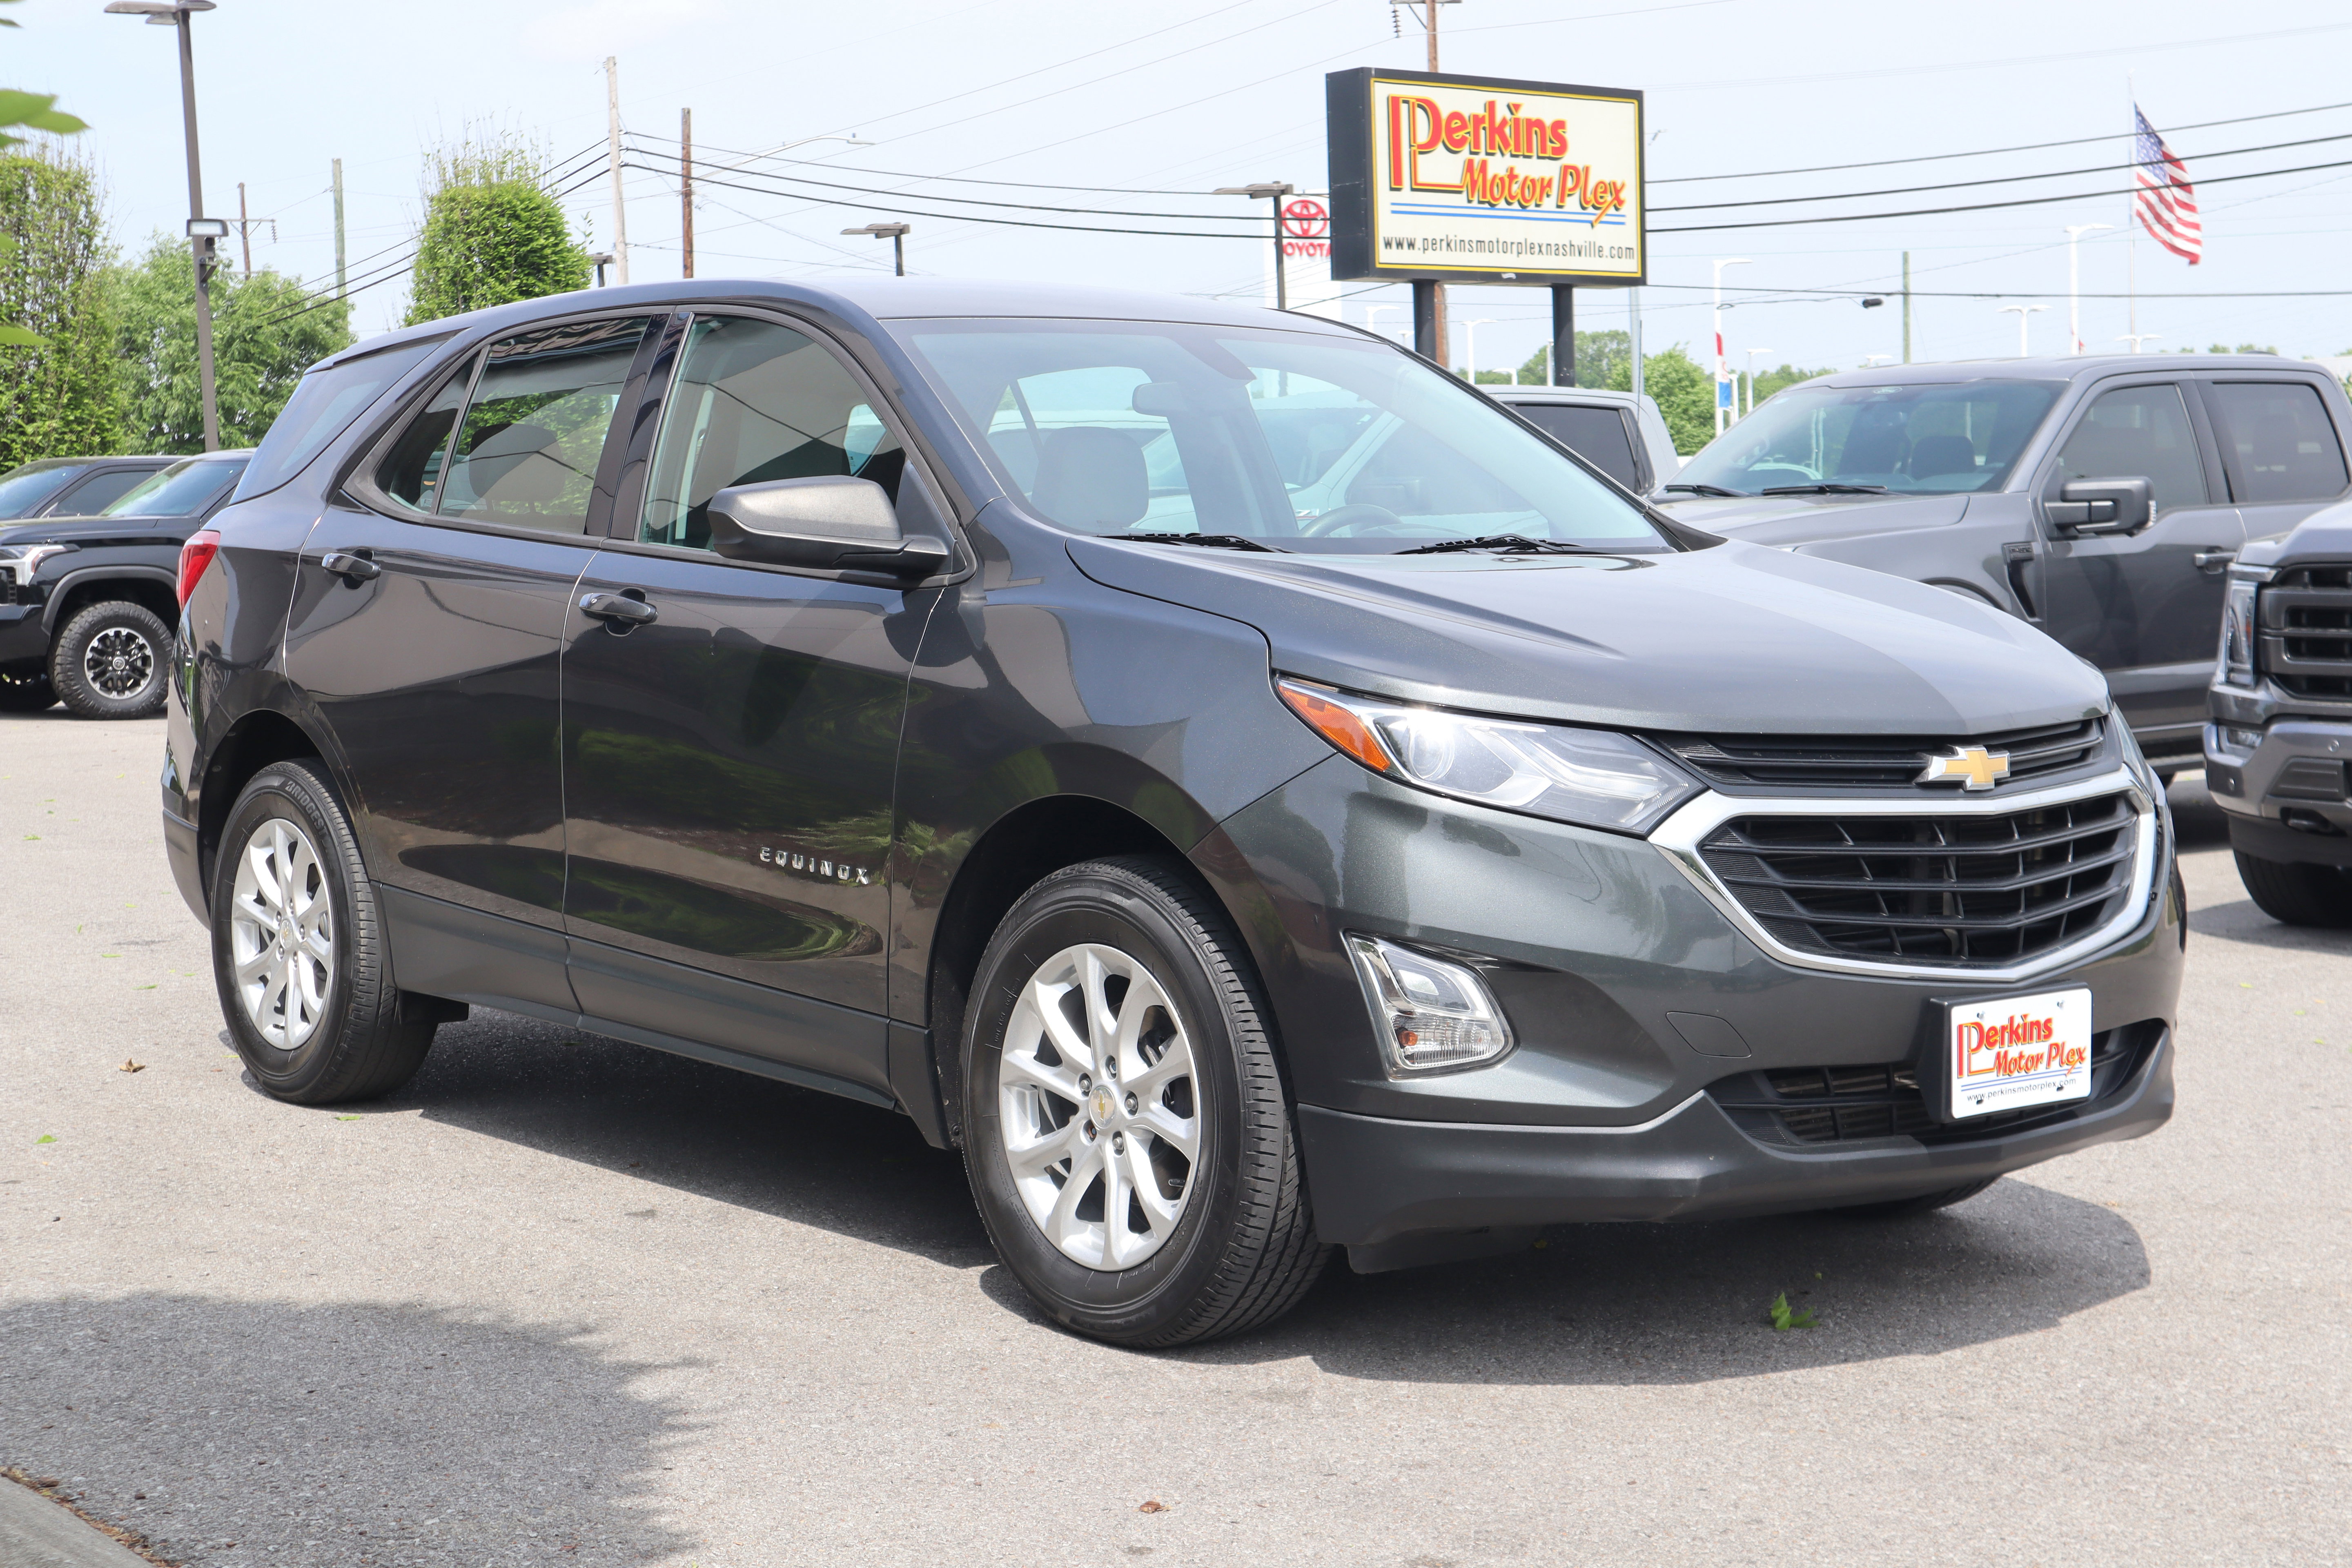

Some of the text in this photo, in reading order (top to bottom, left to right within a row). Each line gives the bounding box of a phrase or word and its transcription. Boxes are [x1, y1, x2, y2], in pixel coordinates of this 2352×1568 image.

[1388, 94, 1569, 190] Perkins
[1463, 158, 1626, 227] Motor Plex
[1383, 235, 1635, 260] www.perkinsmotorplexnashville.com
[760, 847, 869, 884] EQUINOX
[1957, 1013, 2053, 1078] Perkins
[1994, 1041, 2088, 1078] Motor Plex
[1967, 1078, 2076, 1101] www.perkinsmotorplex.com
